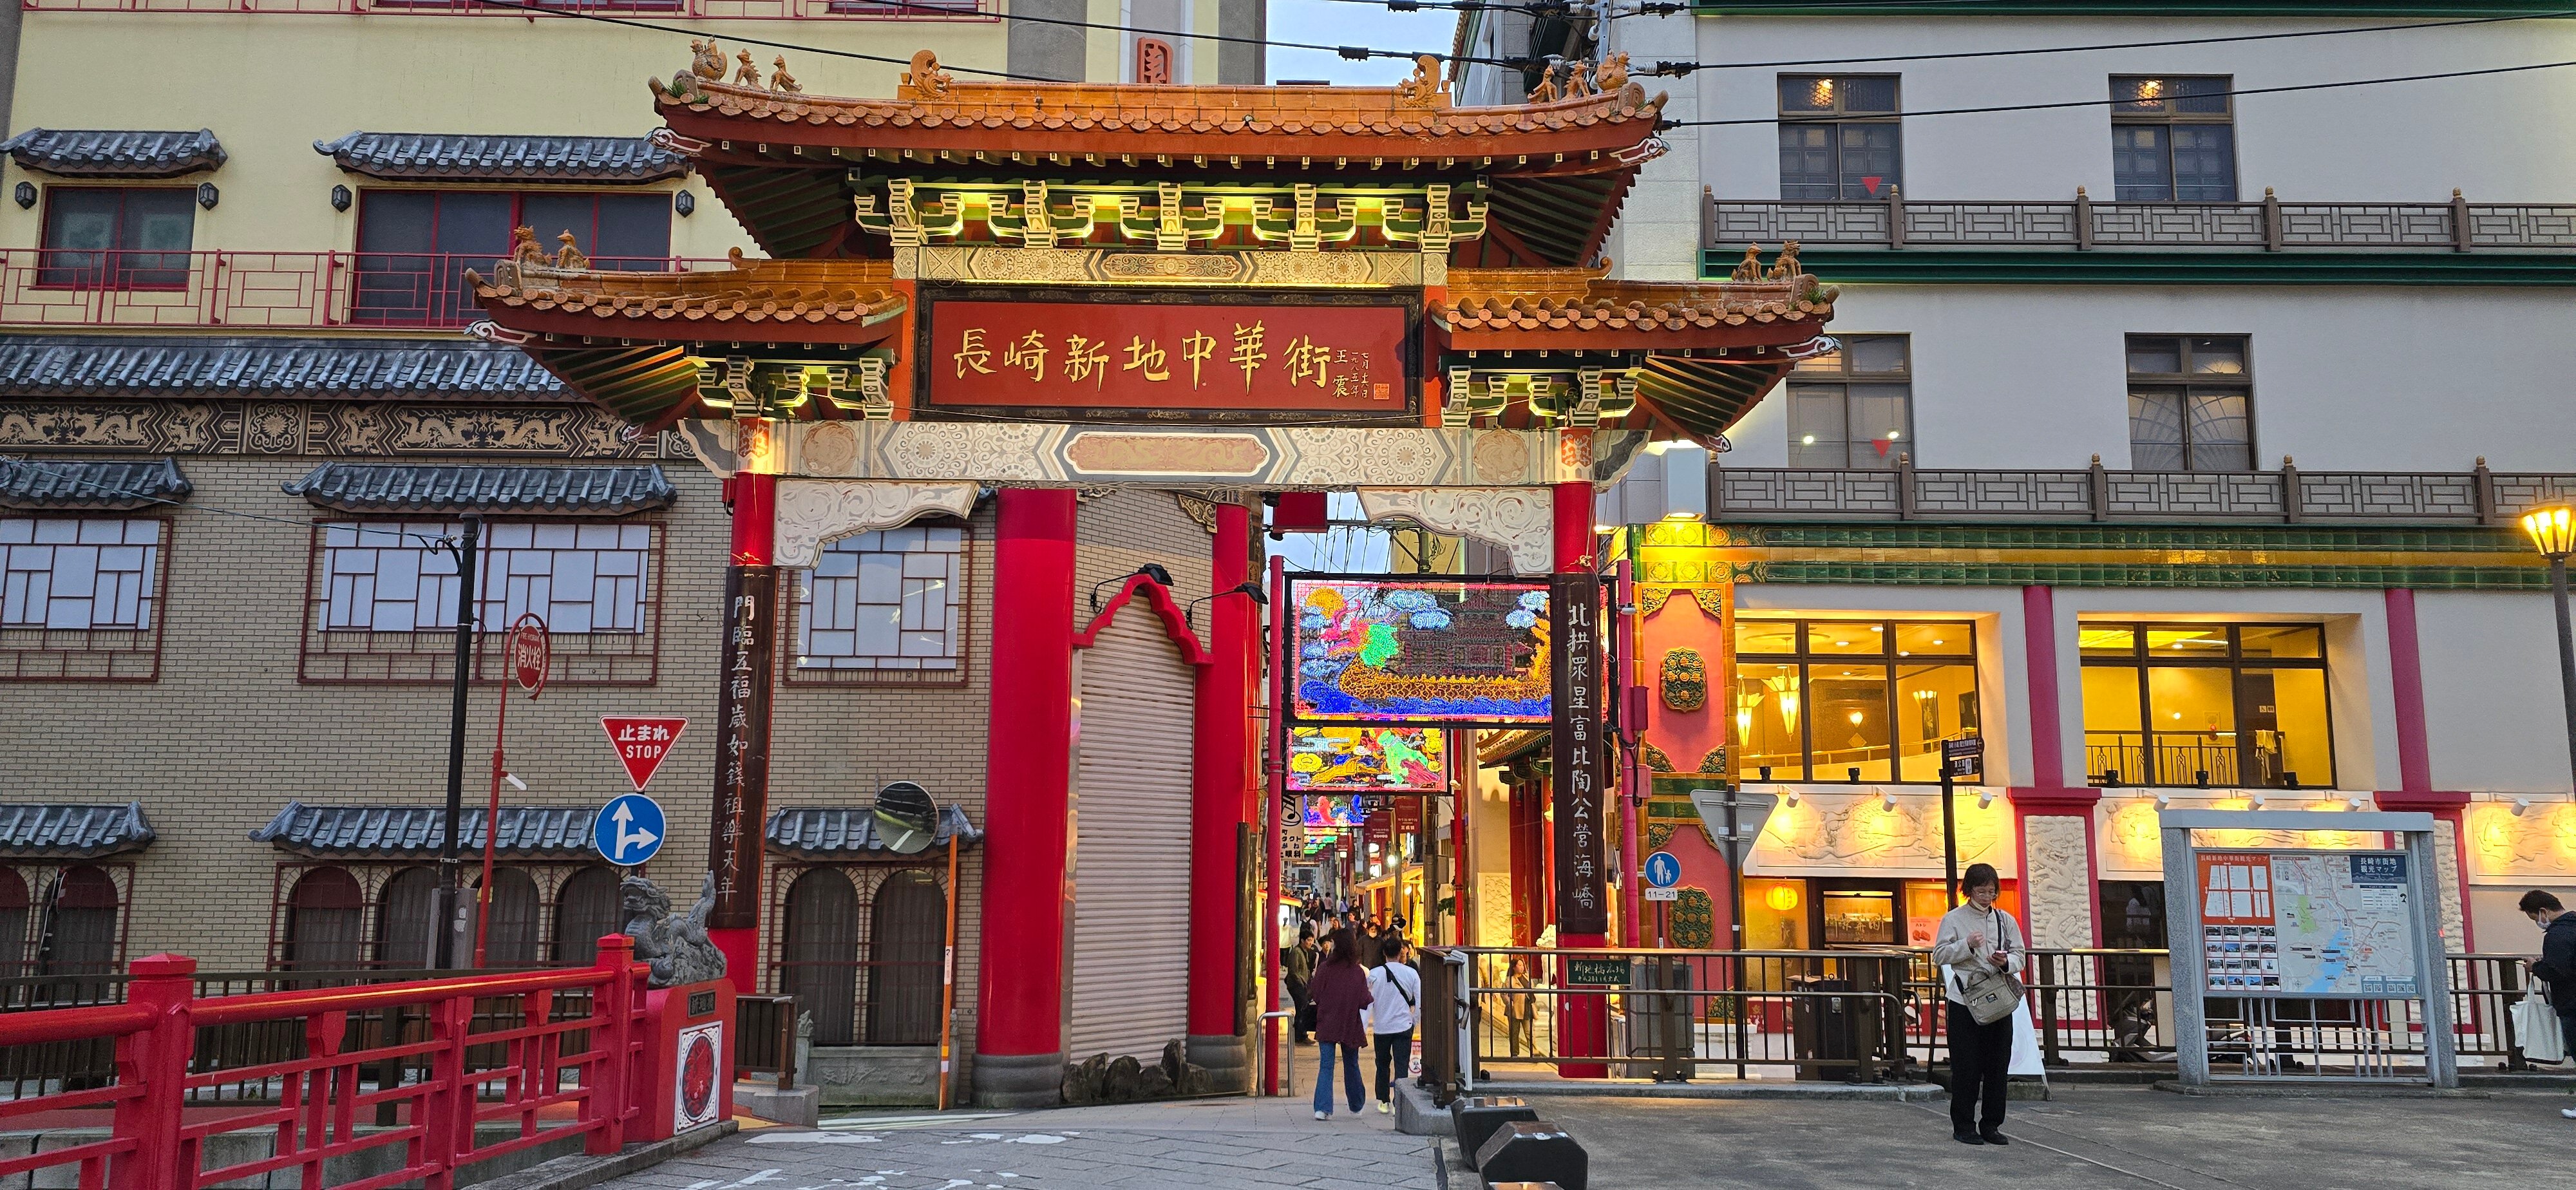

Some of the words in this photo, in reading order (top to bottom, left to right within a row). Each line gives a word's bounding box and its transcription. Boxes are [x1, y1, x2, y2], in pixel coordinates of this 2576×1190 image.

[952, 319, 1331, 393] 長崎新地中華街
[1332, 349, 1350, 398] 王震
[1350, 352, 1359, 397] 一九八五年
[517, 643, 542, 670] 消火栓
[618, 724, 669, 741] 止まれ
[626, 745, 661, 759] STOP
[2360, 857, 2397, 865] 長崎市街地
